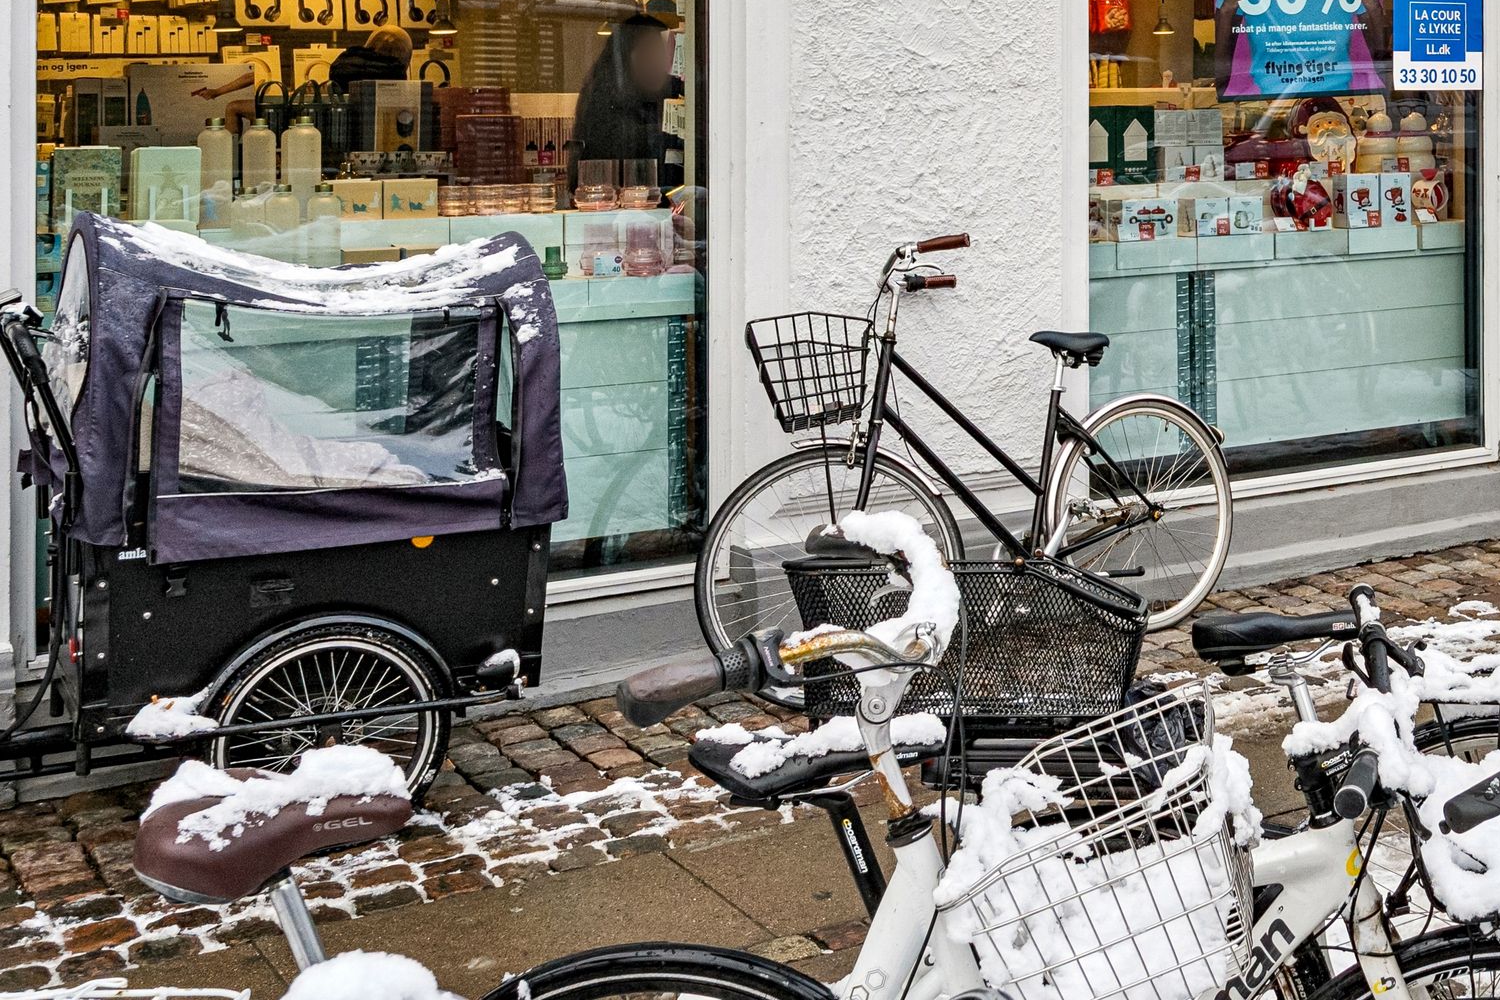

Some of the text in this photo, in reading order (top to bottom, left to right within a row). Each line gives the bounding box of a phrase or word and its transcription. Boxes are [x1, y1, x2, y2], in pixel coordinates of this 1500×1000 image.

[1415, 9, 1461, 21] LA COUR
[1232, 23, 1254, 33] rabat
[1256, 23, 1266, 35] på
[1268, 24, 1297, 34] mange
[1299, 22, 1343, 32] fantastiske
[1419, 23, 1461, 34] & LYKKE
[1426, 43, 1451, 55] LL.dk
[51, 63, 64, 72] og
[67, 62, 88, 72] igen
[1265, 60, 1338, 76] flying tiger
[1400, 69, 1476, 83] 33 30 10 50
[896, 751, 918, 760] dman
[324, 817, 373, 830] GEL
